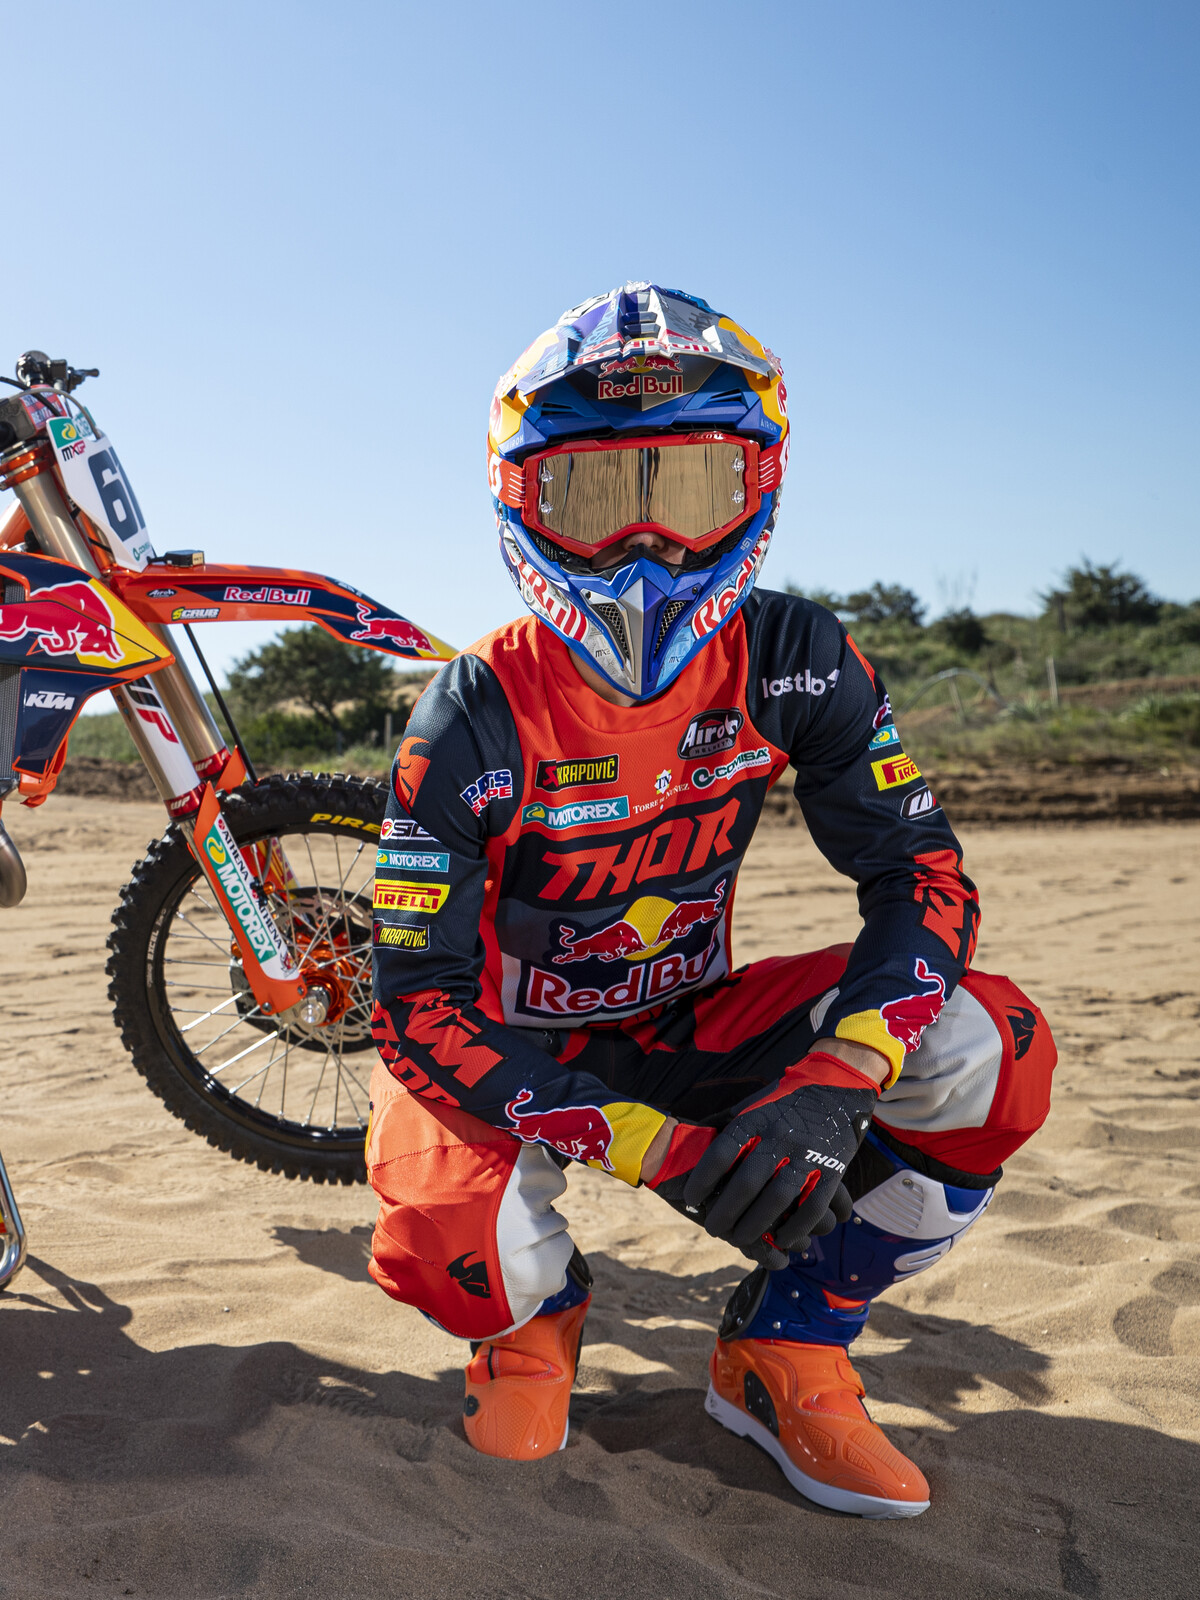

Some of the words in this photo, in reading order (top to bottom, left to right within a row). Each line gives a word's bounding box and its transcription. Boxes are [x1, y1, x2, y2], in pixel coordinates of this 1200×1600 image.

[598, 375, 641, 399] Red
[642, 375, 683, 395] Bull
[224, 587, 266, 603] Red
[267, 588, 310, 606] Bull
[172, 608, 219, 620] SCRUB
[25, 690, 75, 711] KTM
[556, 757, 615, 785] KRAPOVIČ
[714, 748, 770, 778] COMISA
[881, 756, 919, 785] PIRE
[547, 801, 620, 827] MOTOREX
[632, 800, 658, 815] TORRE
[309, 812, 381, 835] PIRE
[221, 830, 249, 881] ATHENA
[389, 853, 441, 869] MOTOREX
[537, 796, 741, 902] THOR
[373, 883, 442, 910] PIRELLI
[216, 861, 274, 961] MOTOREX
[525, 948, 640, 1013] Red
[804, 1149, 846, 1174] THOR
